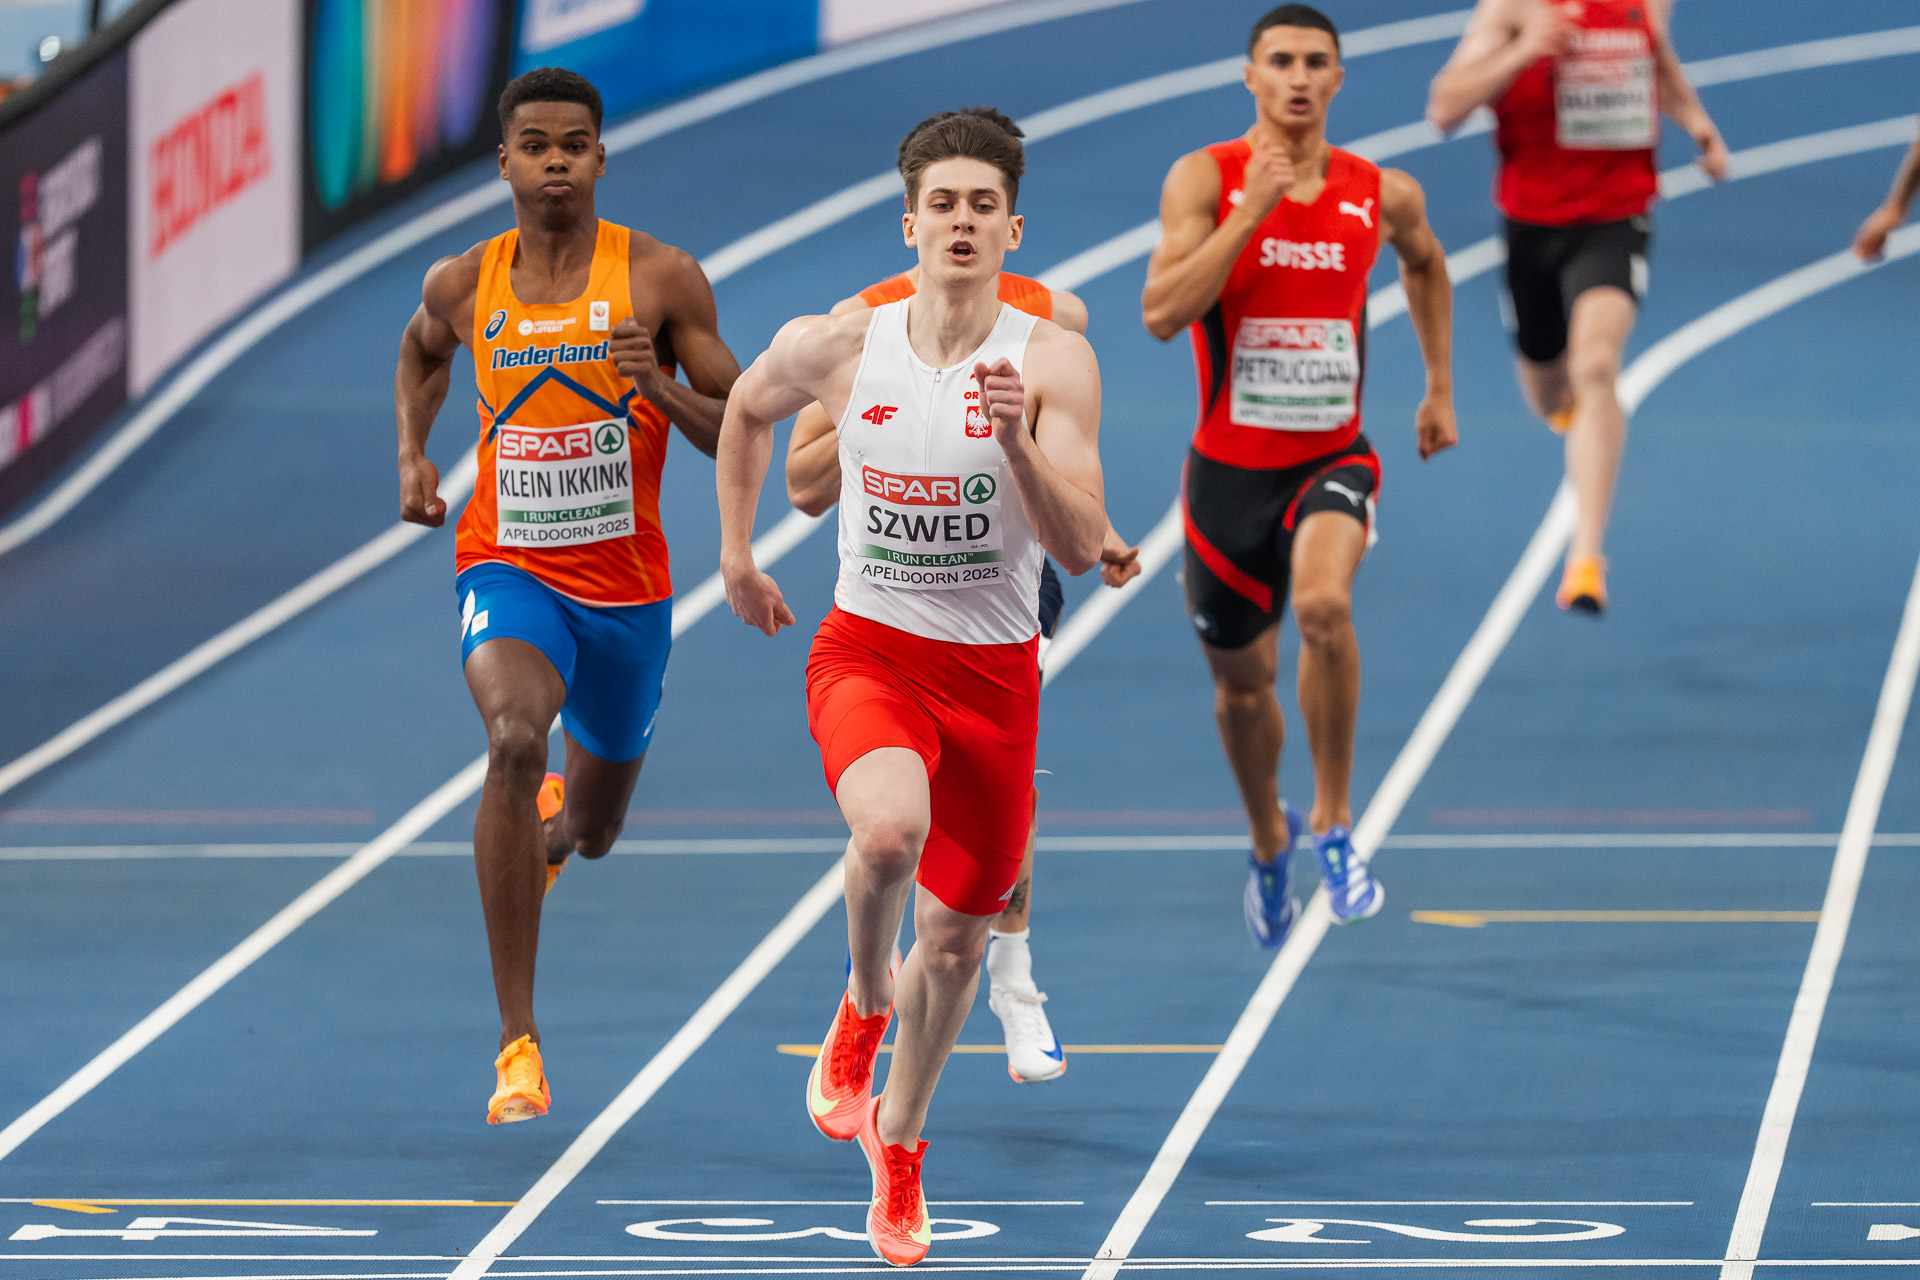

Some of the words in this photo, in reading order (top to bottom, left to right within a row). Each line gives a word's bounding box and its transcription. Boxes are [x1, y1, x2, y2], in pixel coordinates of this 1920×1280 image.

[1259, 237, 1346, 272] SUISSE
[1239, 325, 1323, 347] SPAR
[491, 341, 609, 370] Nederland
[861, 405, 899, 426] 4F
[501, 432, 590, 458] SPAR
[499, 468, 552, 498] KLEIN
[558, 460, 628, 497] IKKINK
[864, 470, 957, 502] SPAR
[529, 510, 559, 522] RUN
[867, 505, 990, 543] SZWED
[503, 525, 594, 541] APELDOORN
[597, 518, 629, 534] 2025
[893, 553, 920, 565] RUN
[861, 564, 958, 584] APELDOORN
[962, 566, 999, 581] 2025
